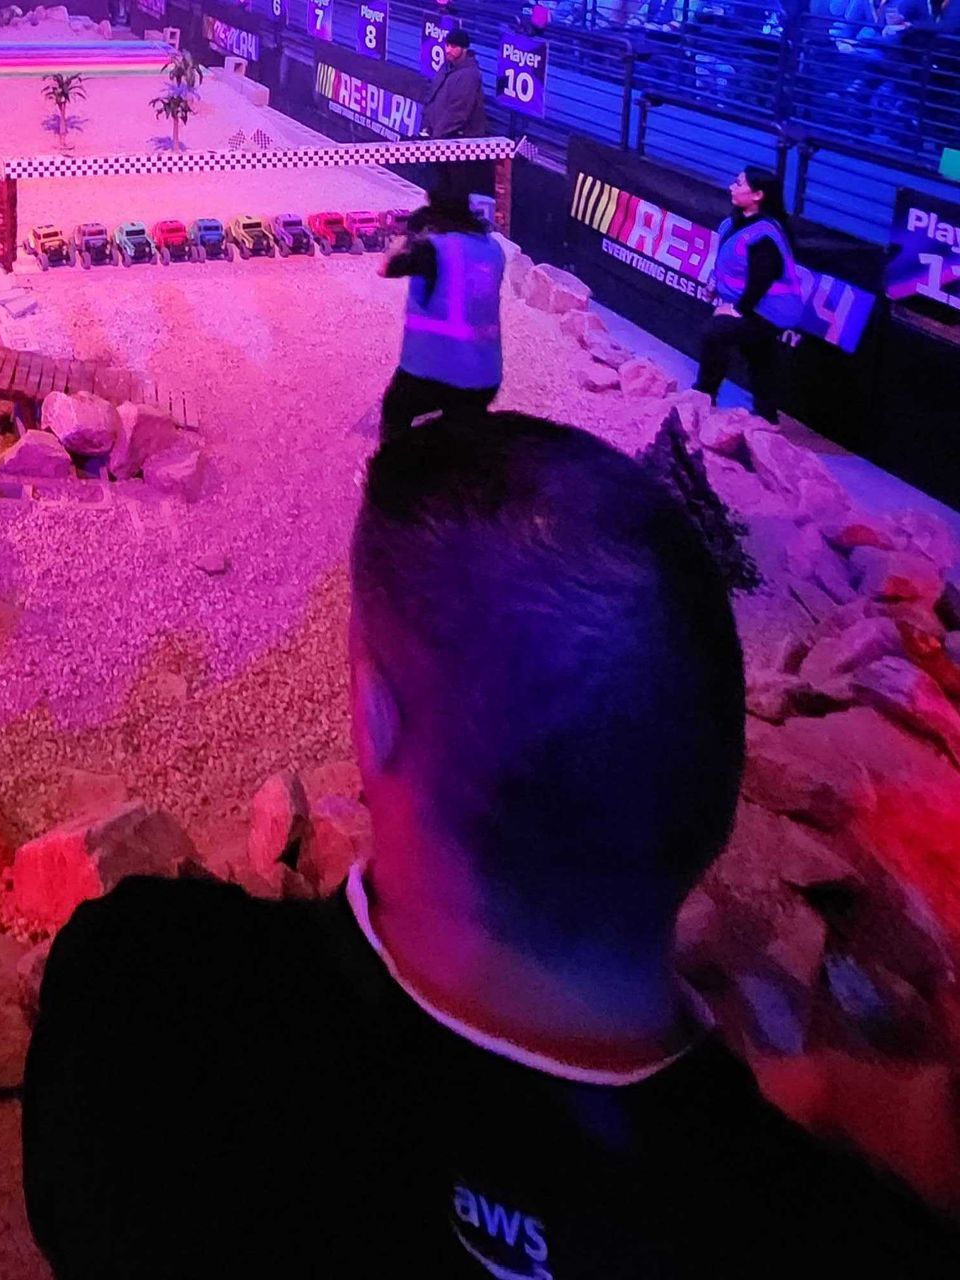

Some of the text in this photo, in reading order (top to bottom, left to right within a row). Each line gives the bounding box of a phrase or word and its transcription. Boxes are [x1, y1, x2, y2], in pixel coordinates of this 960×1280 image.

[314, 9, 324, 30] 7
[360, 5, 385, 24] Player
[365, 25, 377, 49] 8
[425, 22, 449, 42] Play
[431, 45, 445, 72] 9
[503, 43, 542, 69] Player
[503, 68, 535, 103] 10
[338, 72, 417, 137] RE:PLAY
[601, 238, 666, 282] EVERYTHING
[665, 270, 696, 297] ELSE
[454, 1186, 548, 1262] aws
